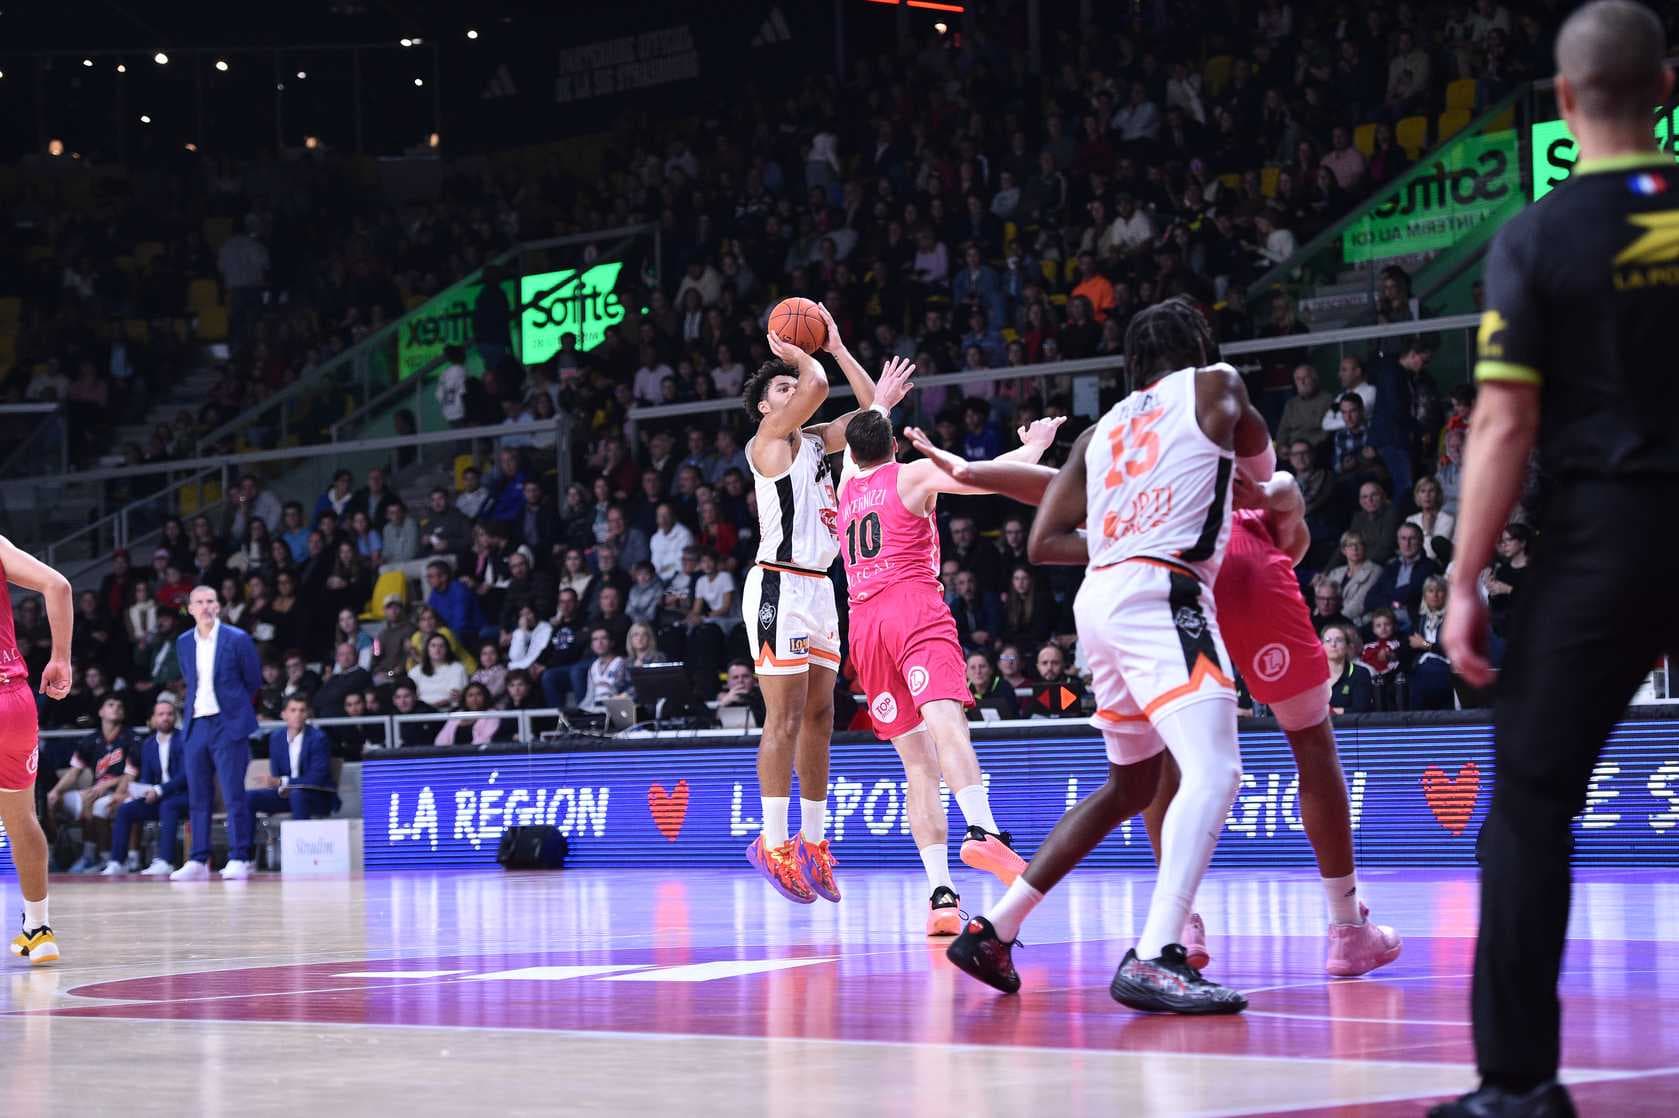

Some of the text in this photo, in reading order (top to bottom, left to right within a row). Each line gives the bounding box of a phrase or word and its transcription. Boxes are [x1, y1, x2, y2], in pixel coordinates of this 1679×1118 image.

[1104, 408, 1165, 489] 15
[846, 512, 881, 566] 10
[875, 697, 891, 715] TOP
[388, 771, 610, 850] LA RÉGION
